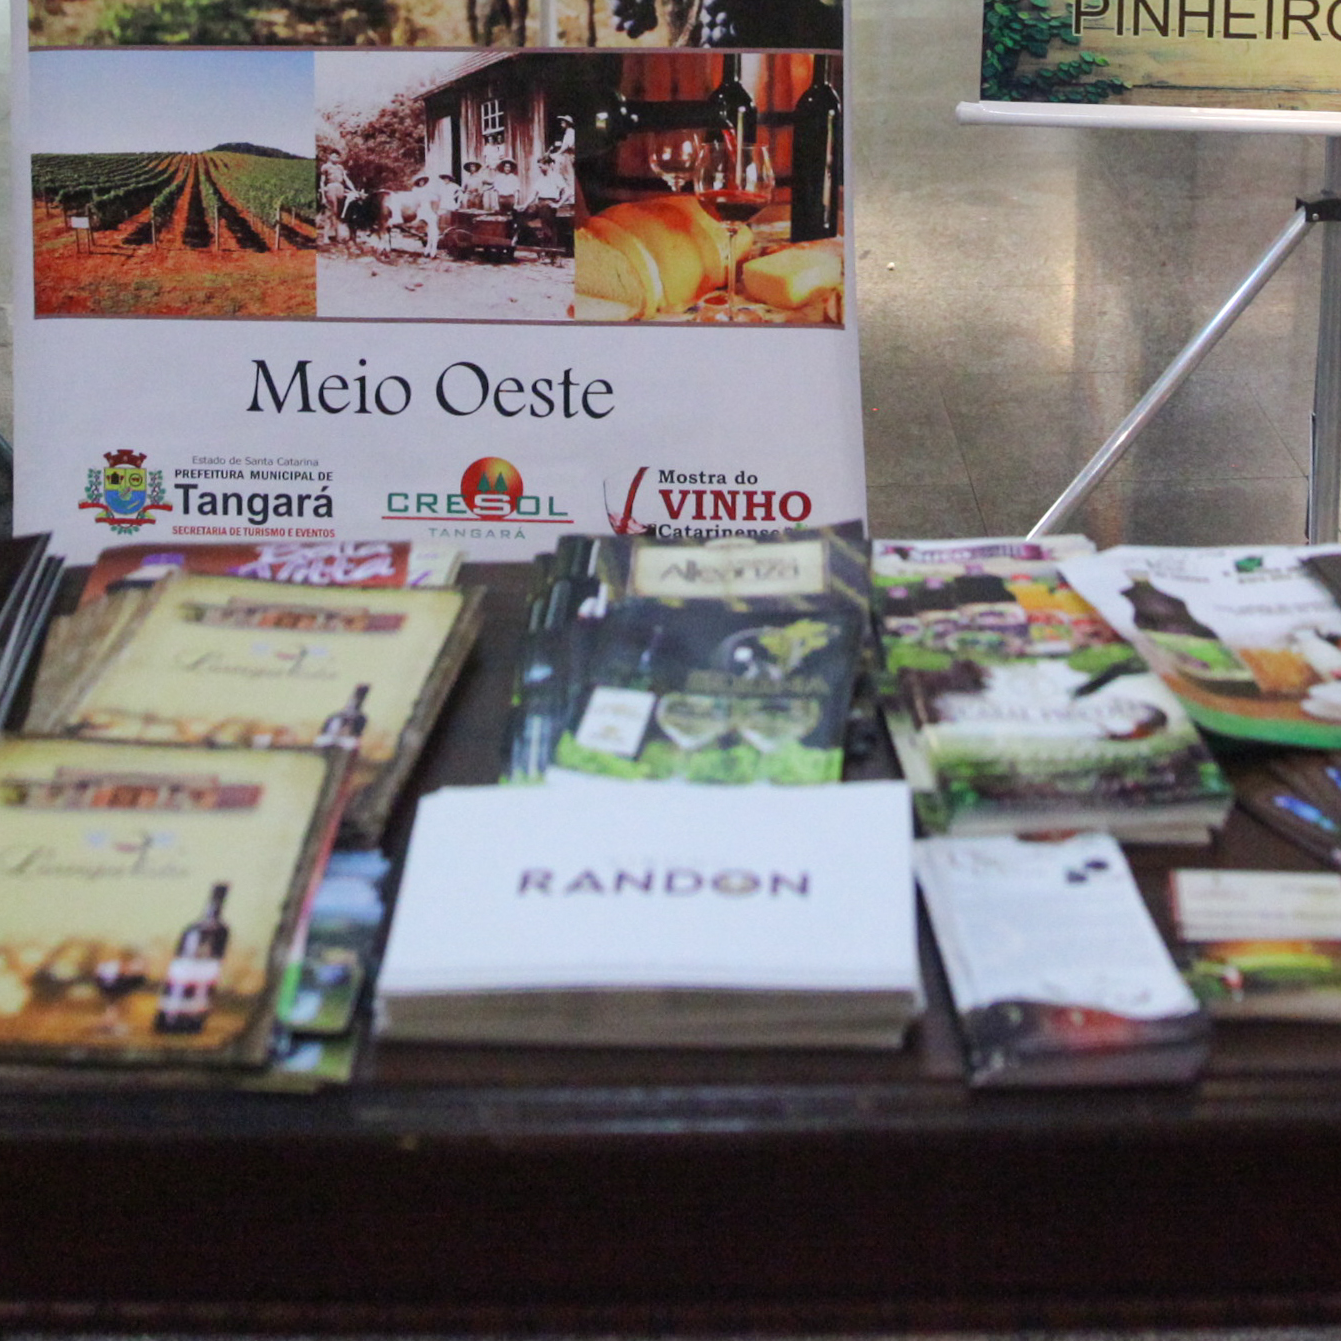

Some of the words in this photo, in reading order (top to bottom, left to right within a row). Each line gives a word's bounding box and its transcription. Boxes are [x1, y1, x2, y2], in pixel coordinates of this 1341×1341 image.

[246, 358, 412, 416] Meio
[435, 360, 616, 420] Oeste
[192, 455, 226, 465] Estado
[229, 456, 242, 465] de
[245, 456, 274, 466] Santa
[277, 456, 319, 467] Catarina
[174, 469, 244, 480] PREFEITURA
[250, 470, 315, 481] MUNICIPAL
[318, 471, 333, 481] DE
[658, 469, 727, 485] Mostra
[734, 469, 759, 485] do
[174, 483, 334, 526] Tangará
[387, 492, 569, 517] CRESOL
[657, 489, 812, 522] VINHO
[172, 525, 228, 536] SECRETARIA
[229, 526, 242, 536] DE
[243, 526, 286, 537] TURISMO
[287, 527, 294, 537] E
[295, 527, 336, 538] EVENTOS
[428, 527, 527, 540] TANGARÁ
[518, 867, 812, 898] RANDON
